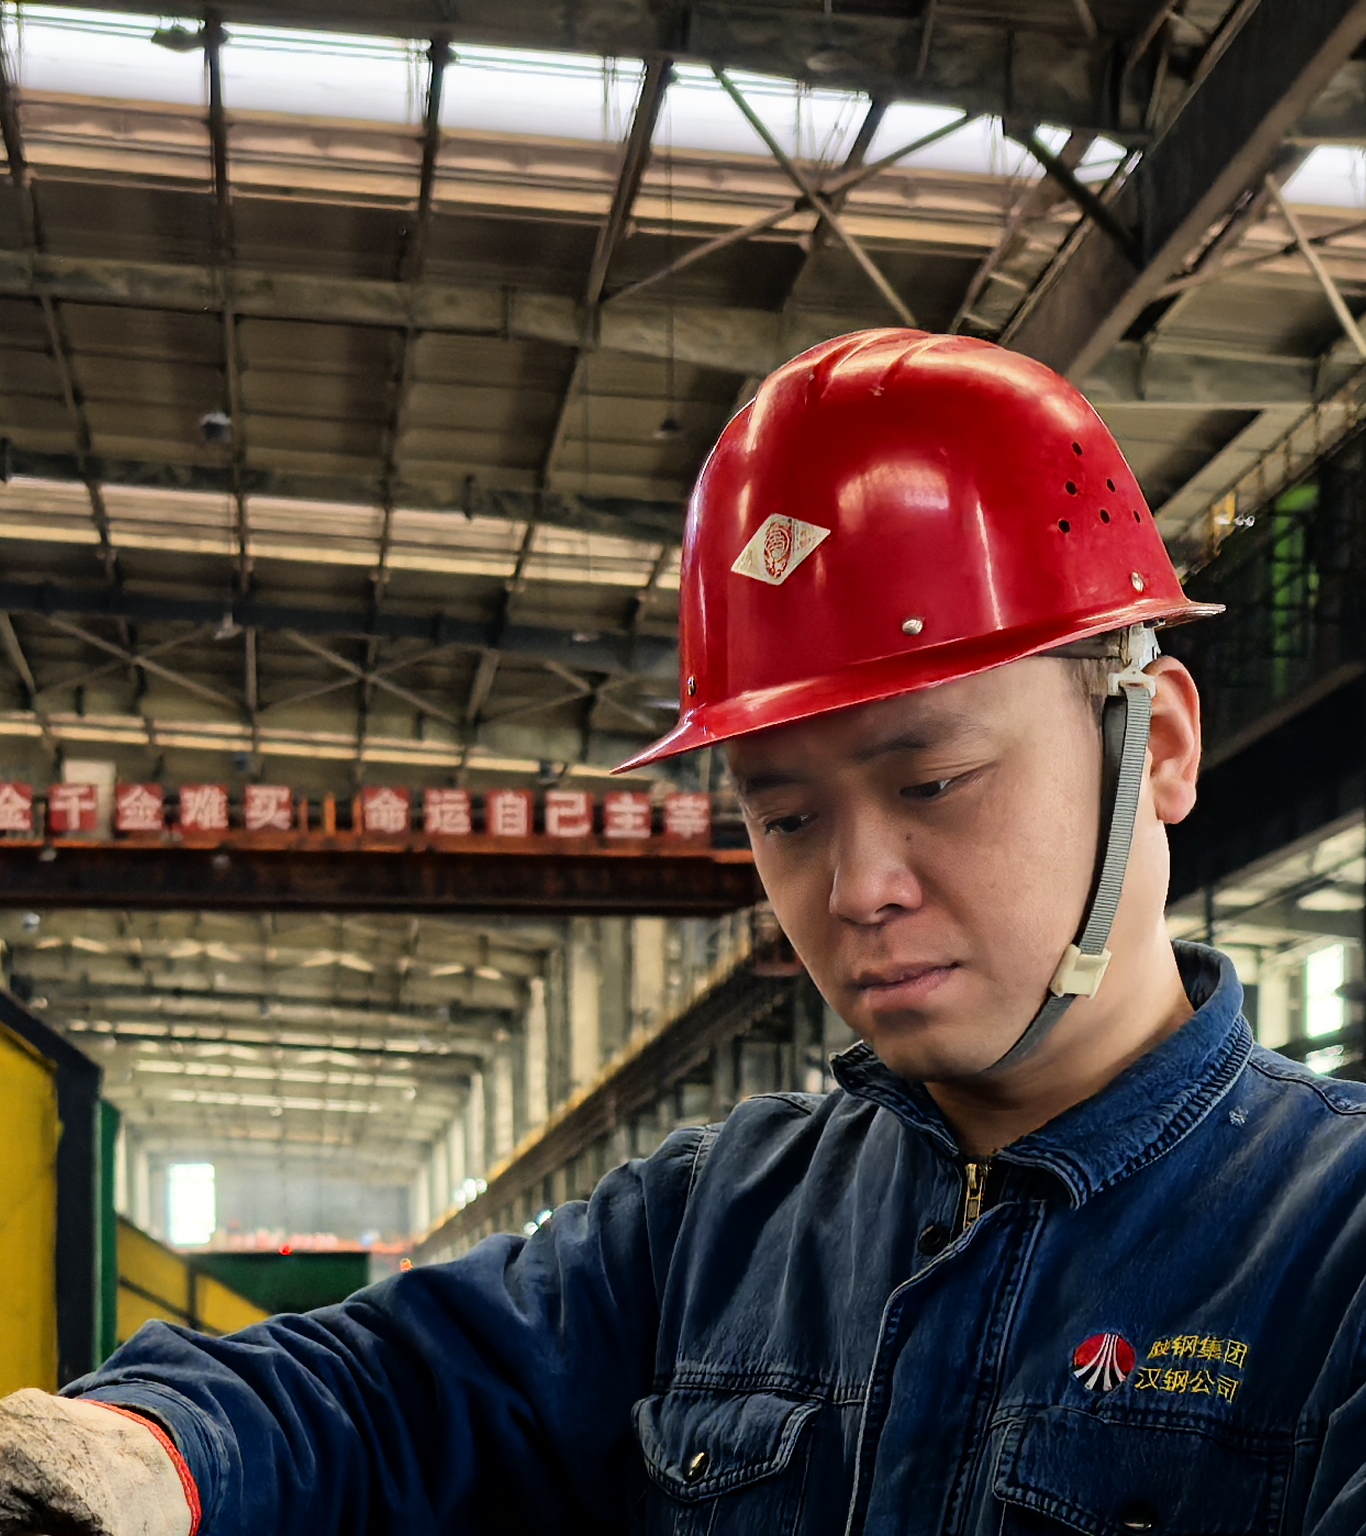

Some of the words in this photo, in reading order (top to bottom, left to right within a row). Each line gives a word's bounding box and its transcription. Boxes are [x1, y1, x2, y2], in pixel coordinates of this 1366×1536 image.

[366, 787, 711, 837] 命运自己主宰
[1135, 1365, 1240, 1404] 汉钢公司
